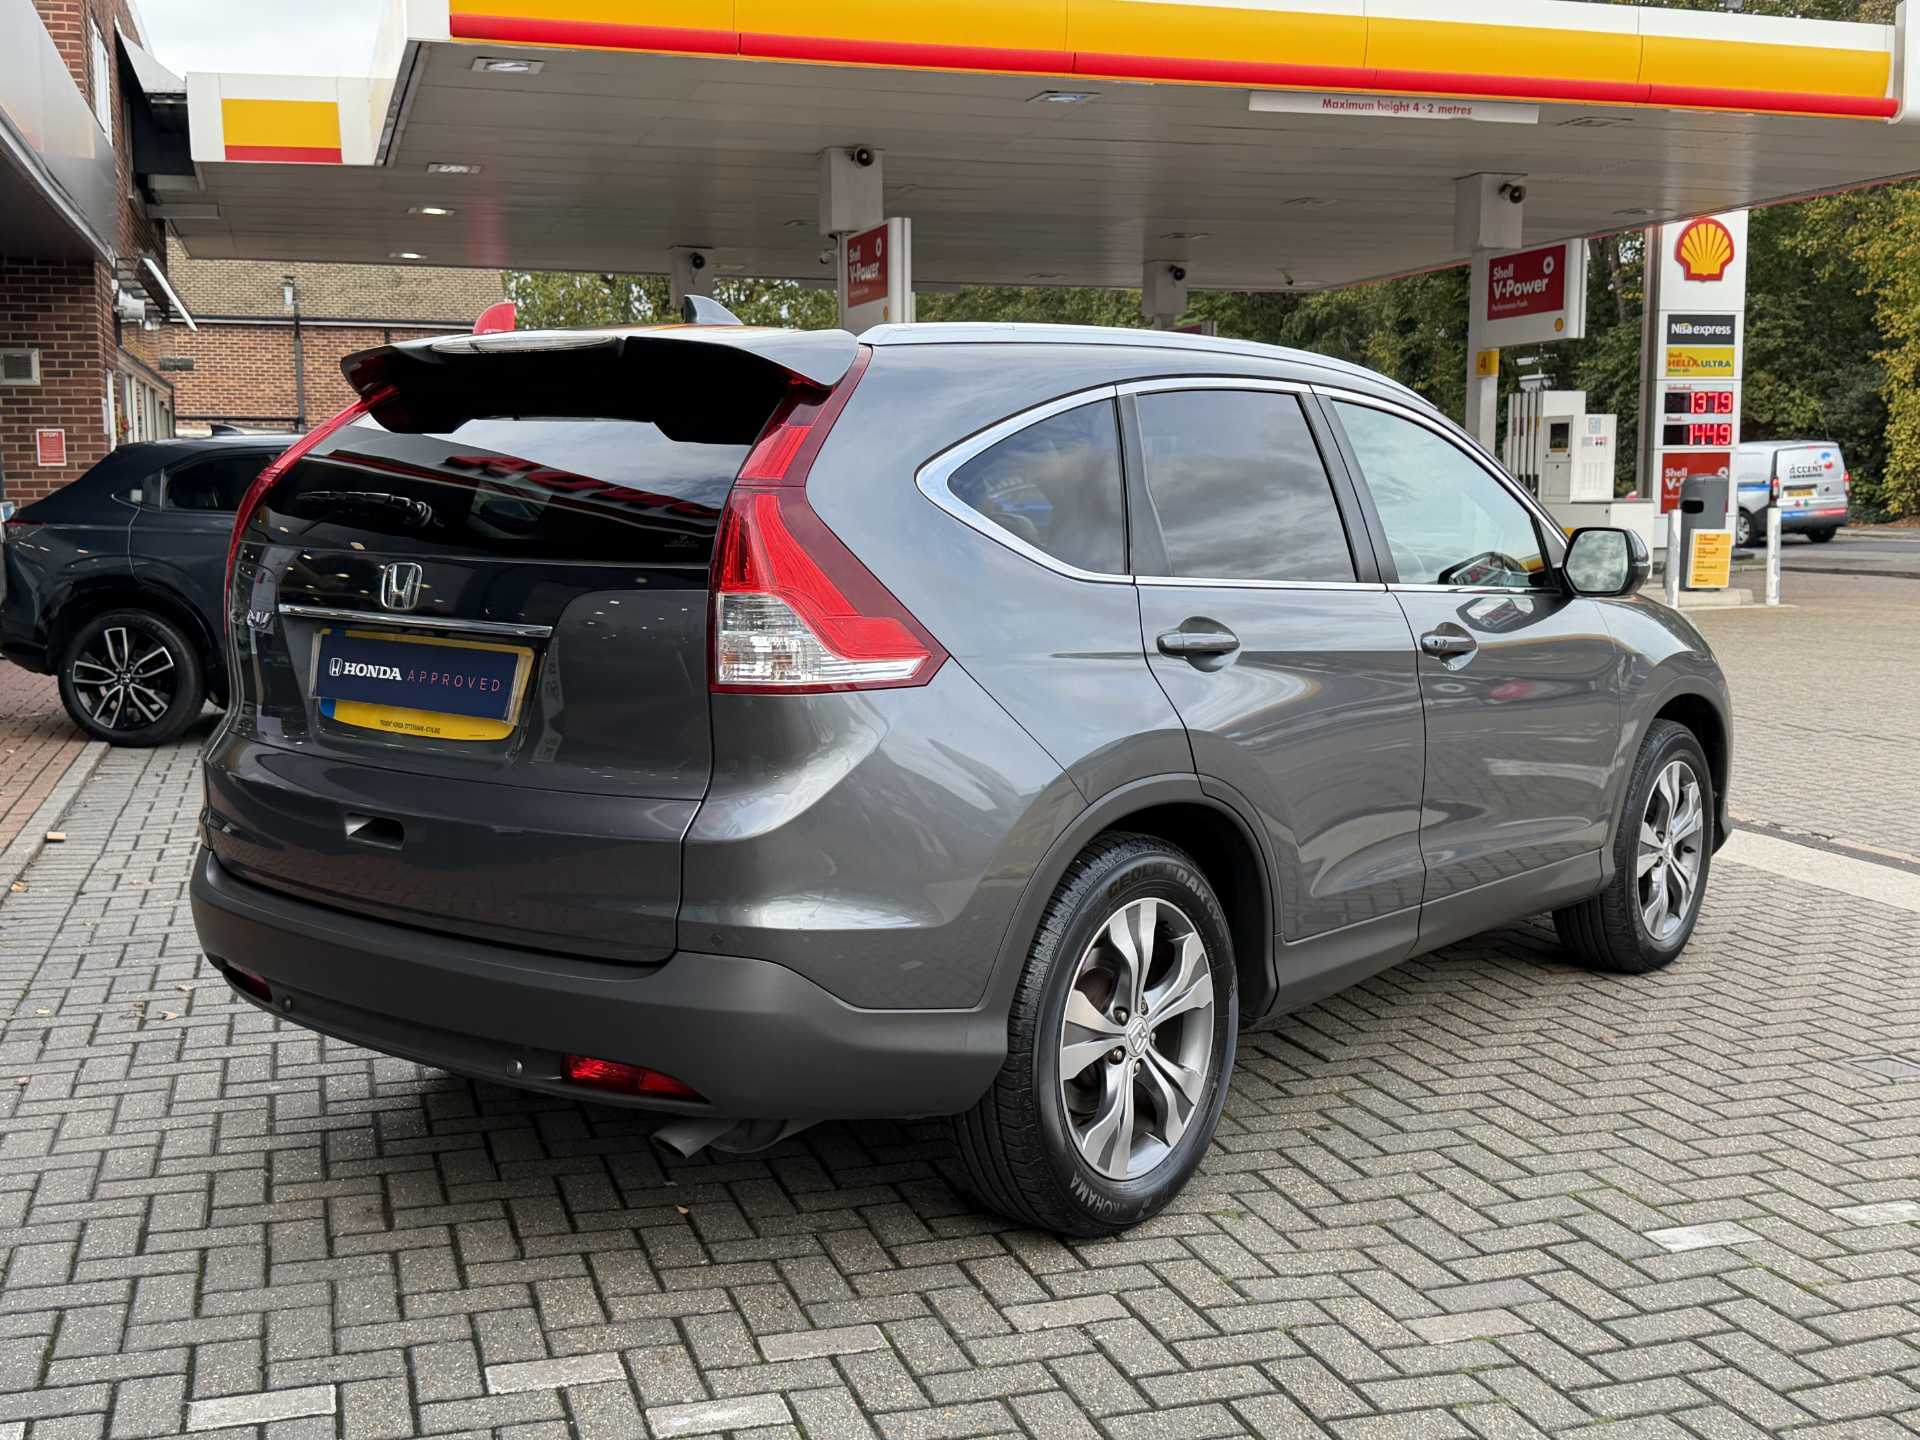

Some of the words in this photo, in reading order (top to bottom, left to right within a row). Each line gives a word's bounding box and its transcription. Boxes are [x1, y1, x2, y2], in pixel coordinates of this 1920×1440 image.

[1322, 98, 1374, 111] Maximum
[1377, 100, 1409, 114] height
[1438, 104, 1472, 116] metres
[1493, 263, 1514, 281] Shell
[1671, 323, 1693, 335] Nisa
[1693, 325, 1732, 337] express
[1480, 356, 1487, 370] 4
[1667, 358, 1700, 368] HELIX
[1700, 359, 1731, 368] ULTRA
[1690, 392, 1732, 413] 137.9
[1689, 424, 1731, 445] 144.9
[1664, 467, 1688, 477] Shell
[343, 662, 403, 681] HONDA
[407, 670, 501, 692] APPROVED
